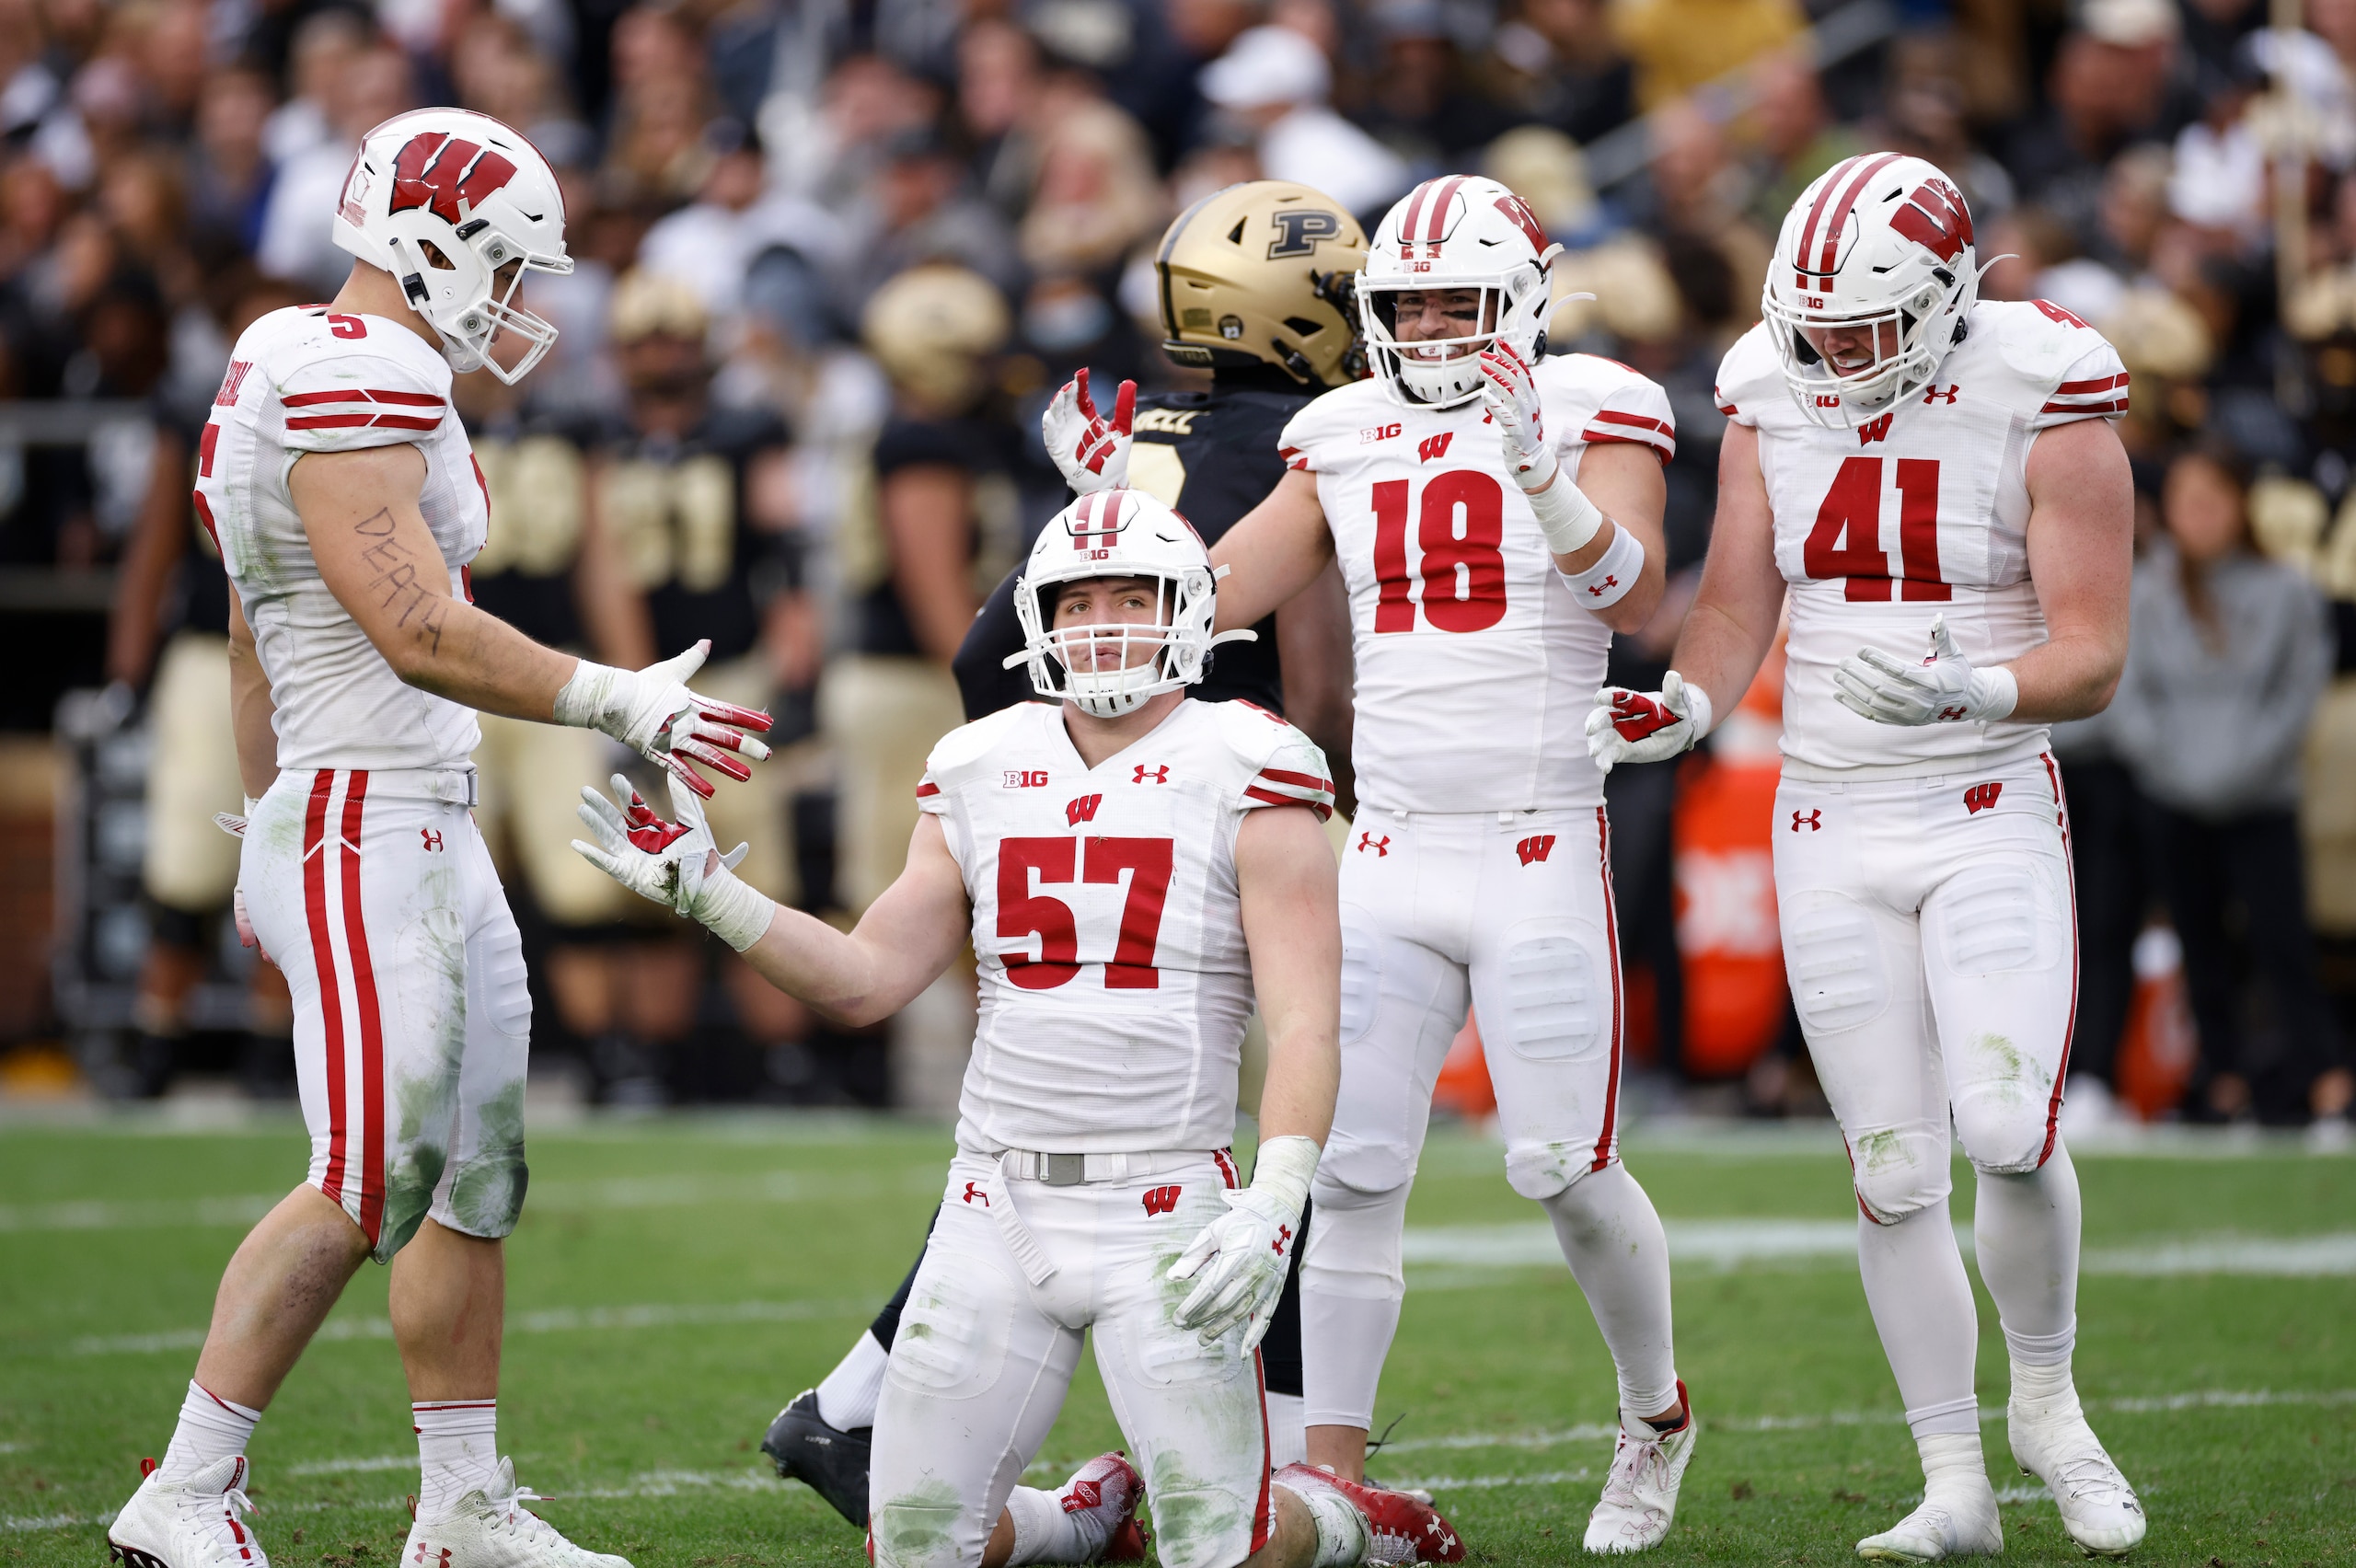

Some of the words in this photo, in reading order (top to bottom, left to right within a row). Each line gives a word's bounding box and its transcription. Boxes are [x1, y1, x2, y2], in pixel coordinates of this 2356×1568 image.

[388, 132, 518, 225] W
[1266, 209, 1340, 260] P
[328, 312, 367, 340] 5
[1857, 413, 1894, 448] W
[1417, 432, 1453, 465] W
[1804, 456, 1952, 602] 41
[1371, 469, 1507, 633] 18
[354, 507, 449, 657] DEATH
[1065, 793, 1103, 827] W
[1963, 782, 2003, 815] W
[1516, 835, 1556, 867] W
[997, 836, 1173, 989] 57
[1142, 1185, 1182, 1217] W
